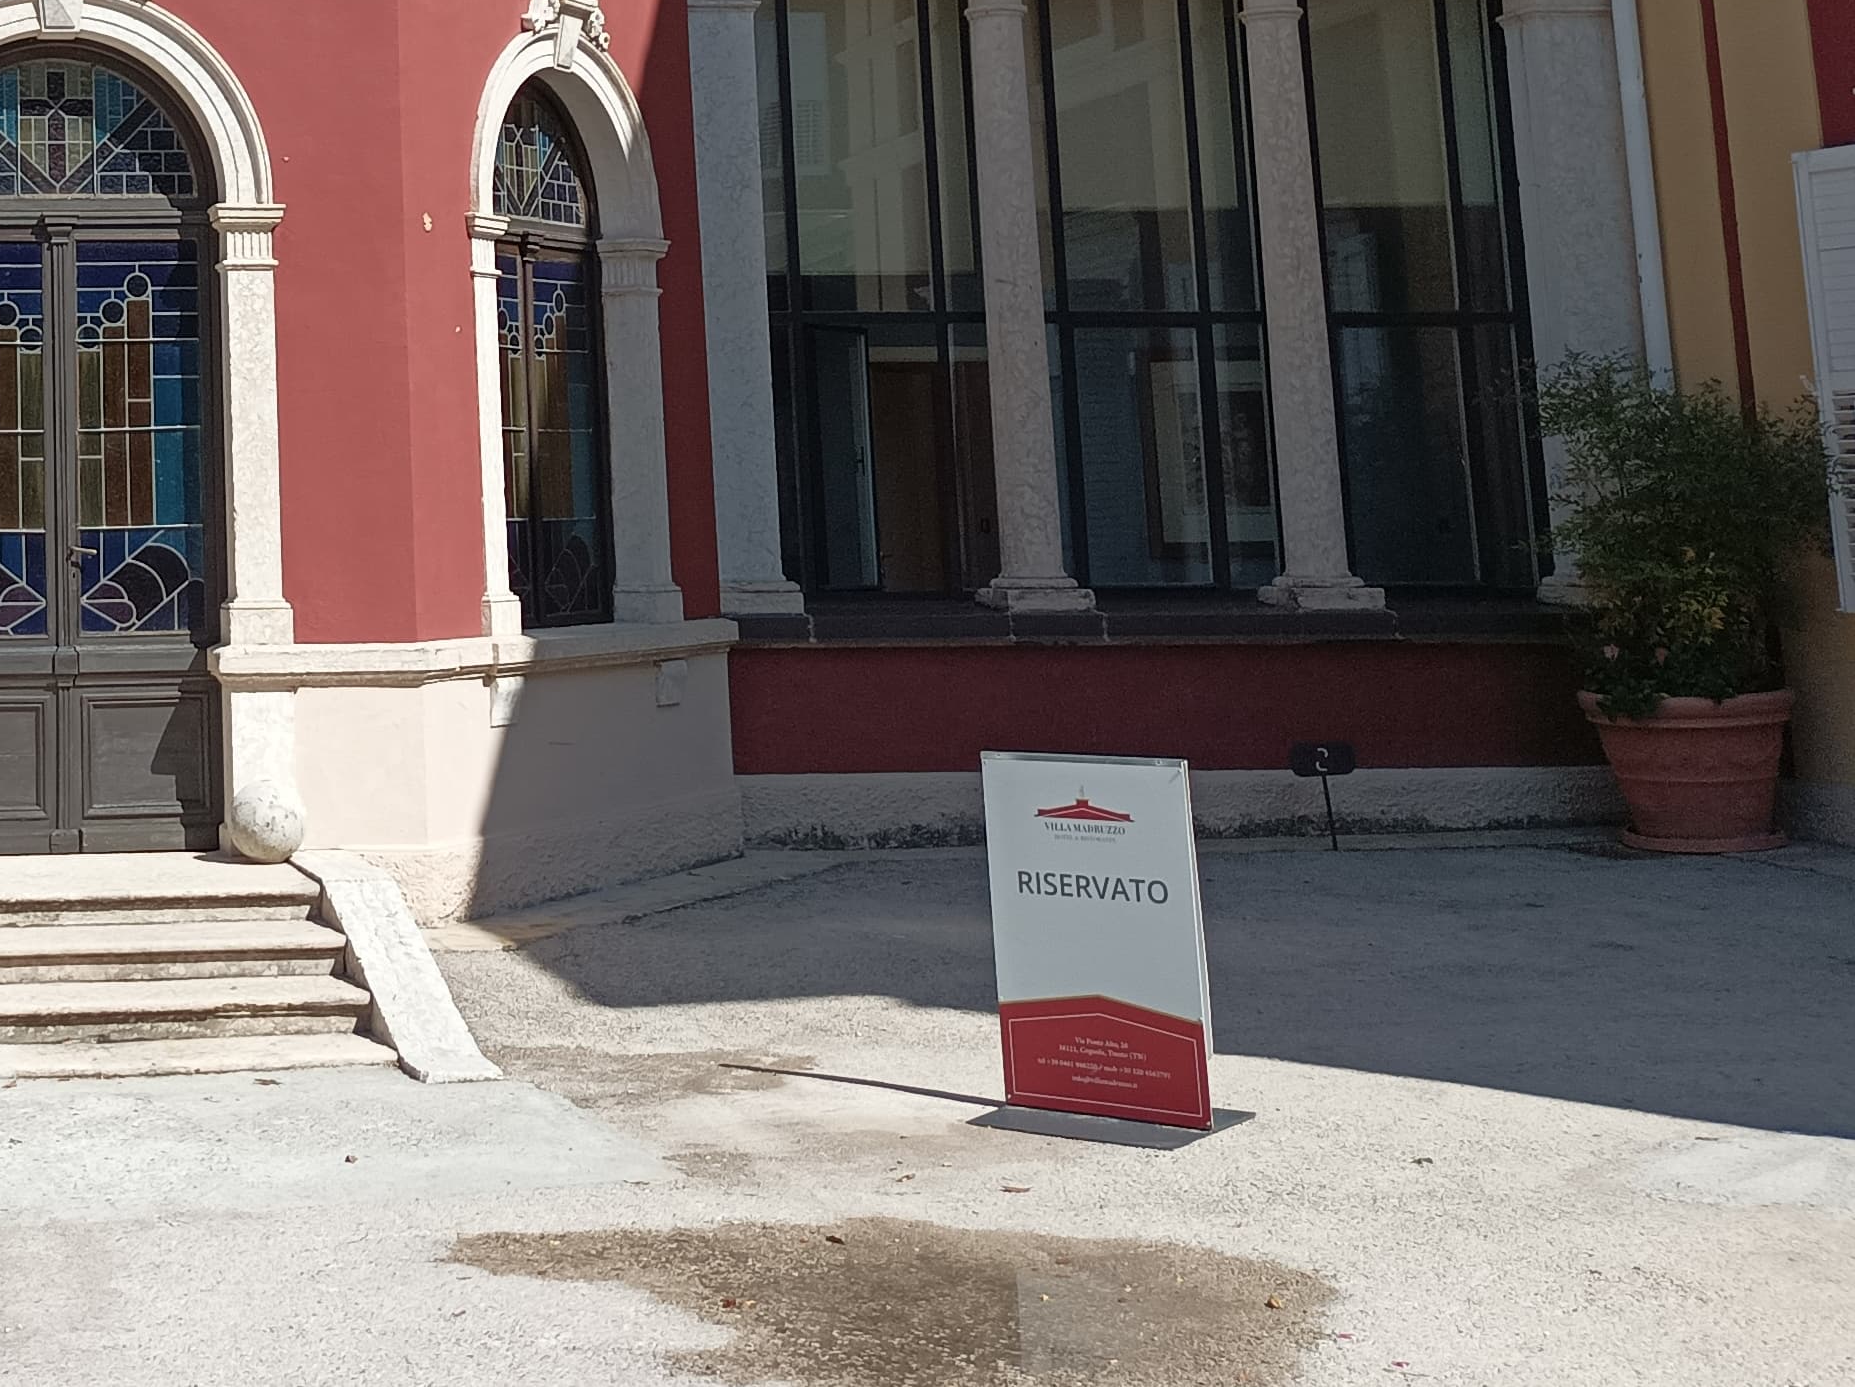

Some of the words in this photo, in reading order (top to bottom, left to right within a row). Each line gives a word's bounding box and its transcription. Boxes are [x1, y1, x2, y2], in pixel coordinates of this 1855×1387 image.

[1044, 821, 1071, 832] VILLA
[1073, 824, 1126, 835] MADRUZZO
[1016, 869, 1170, 905] RISERVATO
